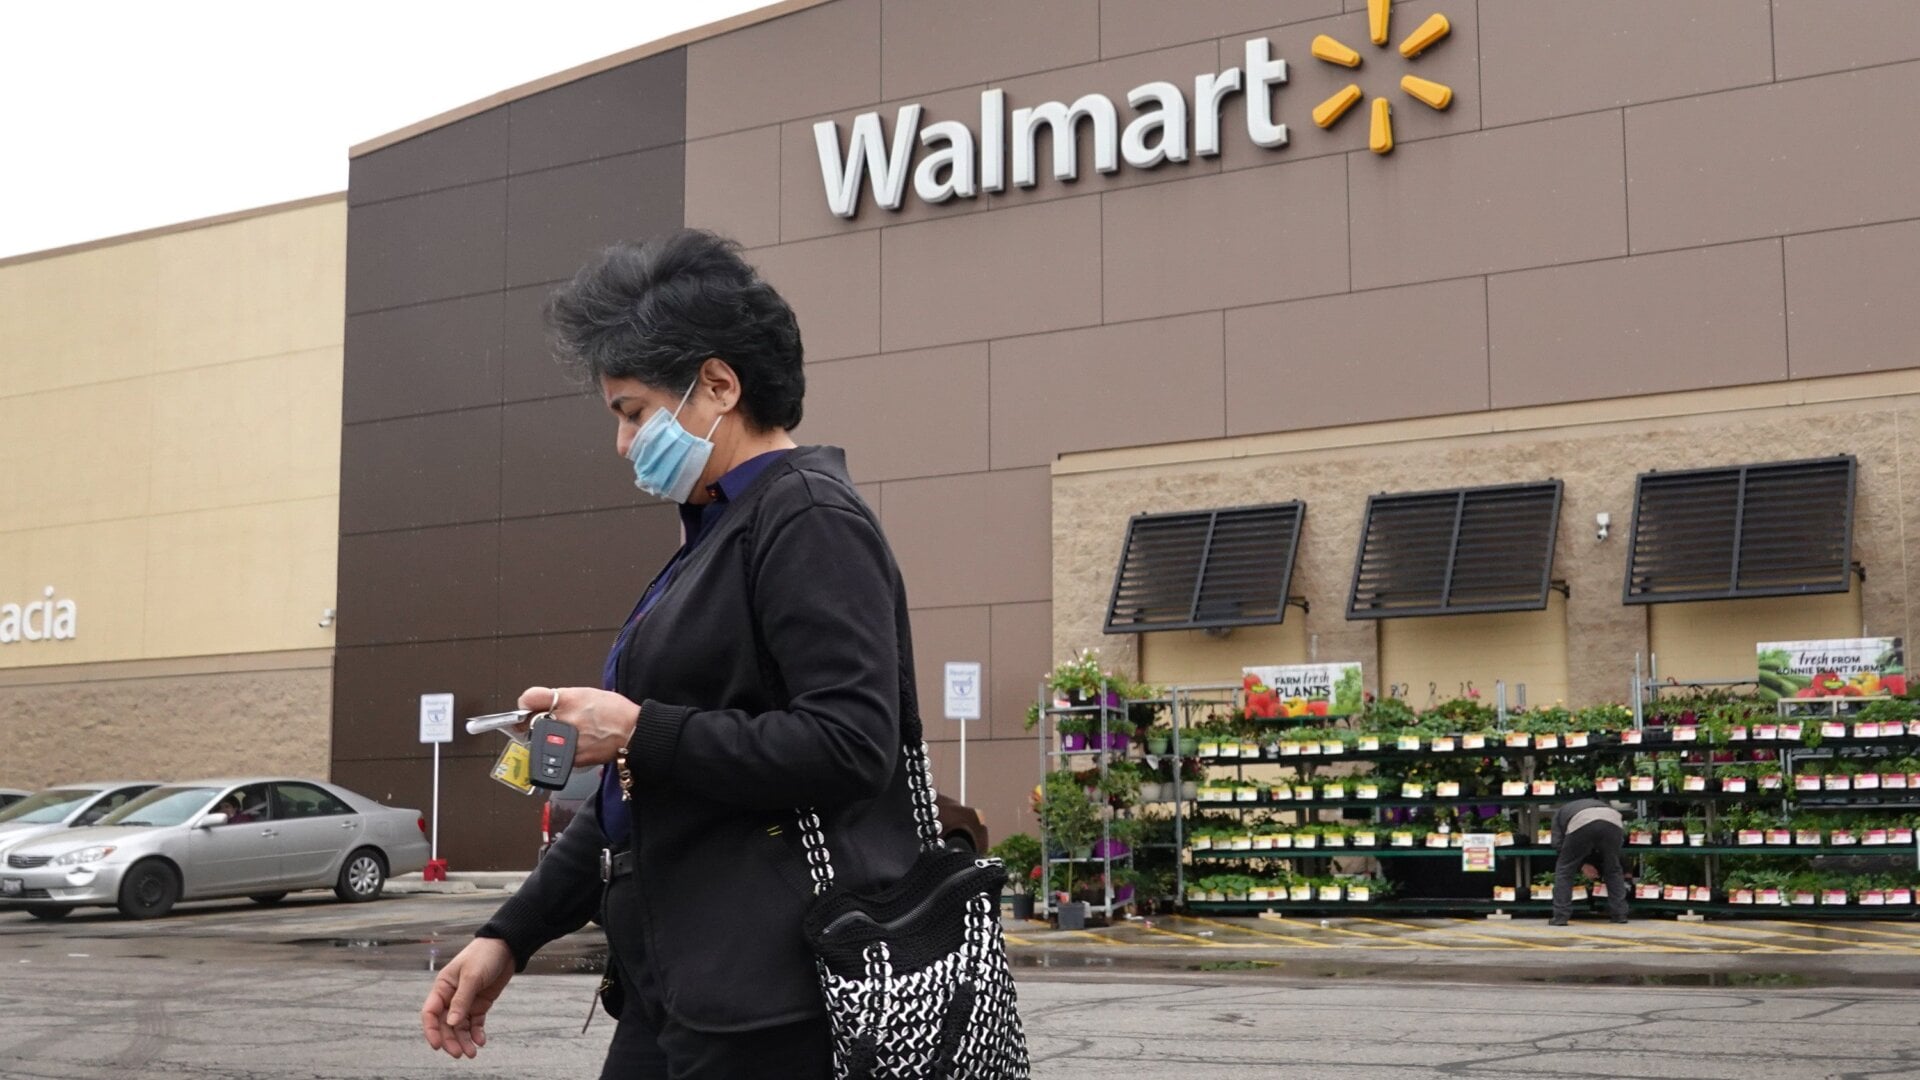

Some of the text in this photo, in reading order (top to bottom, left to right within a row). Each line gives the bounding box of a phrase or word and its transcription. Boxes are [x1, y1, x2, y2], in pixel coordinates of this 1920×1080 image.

[813, 37, 1288, 218] Walmart
[0, 585, 76, 643] acia
[1799, 652, 1860, 665] fresh FROM
[1852, 664, 1885, 672] FARMS
[1304, 672, 1329, 683] fresh
[1275, 685, 1331, 697] PLANTS
